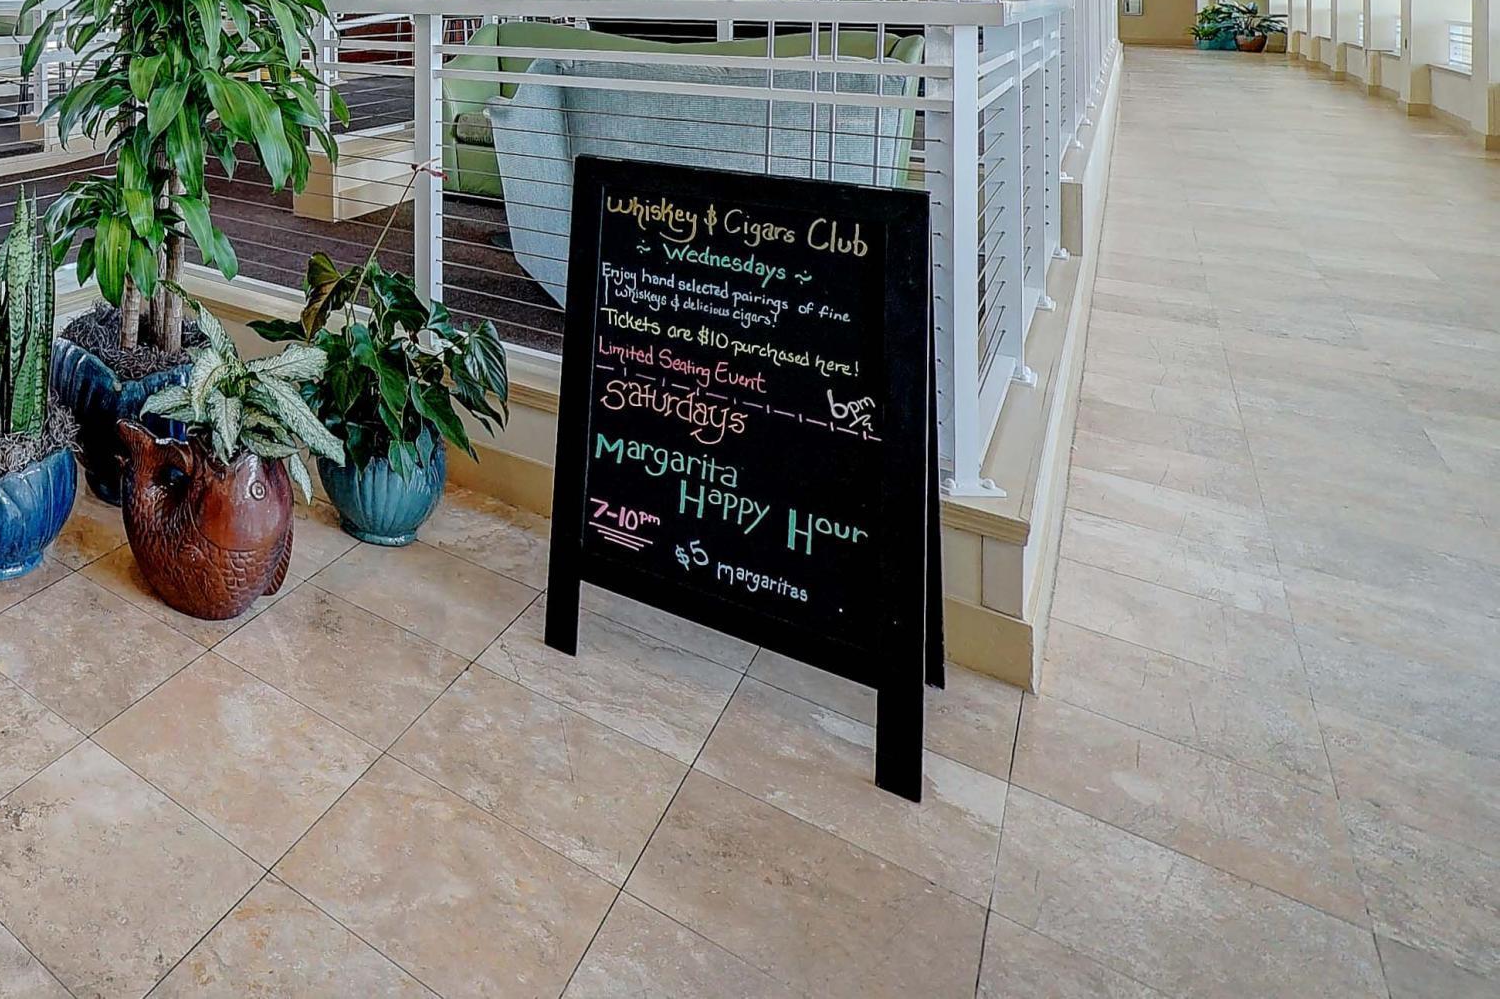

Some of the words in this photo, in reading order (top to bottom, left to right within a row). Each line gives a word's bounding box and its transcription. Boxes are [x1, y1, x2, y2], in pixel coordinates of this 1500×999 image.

[724, 208, 796, 247] Cigars
[807, 217, 869, 258] Club
[601, 262, 638, 289] Enjoy
[642, 268, 675, 289] hand
[678, 280, 729, 299] selected
[732, 290, 789, 315] pairings
[798, 302, 814, 315] of
[819, 304, 852, 323] fine
[663, 243, 788, 288] Wednesdays
[683, 297, 730, 317] delicious
[599, 335, 654, 366] Limited
[658, 347, 712, 389] Seating
[714, 361, 767, 392] Event
[601, 307, 662, 336] Tickets
[667, 324, 694, 342] are
[697, 325, 729, 350] $10
[731, 340, 810, 367] purchased
[815, 355, 860, 377] here!
[600, 378, 750, 445] Saturdays
[594, 432, 739, 488] Margarita
[679, 480, 770, 535] Happy
[787, 508, 869, 556] Hour
[675, 539, 709, 571] $5
[717, 561, 808, 602] margaritas
